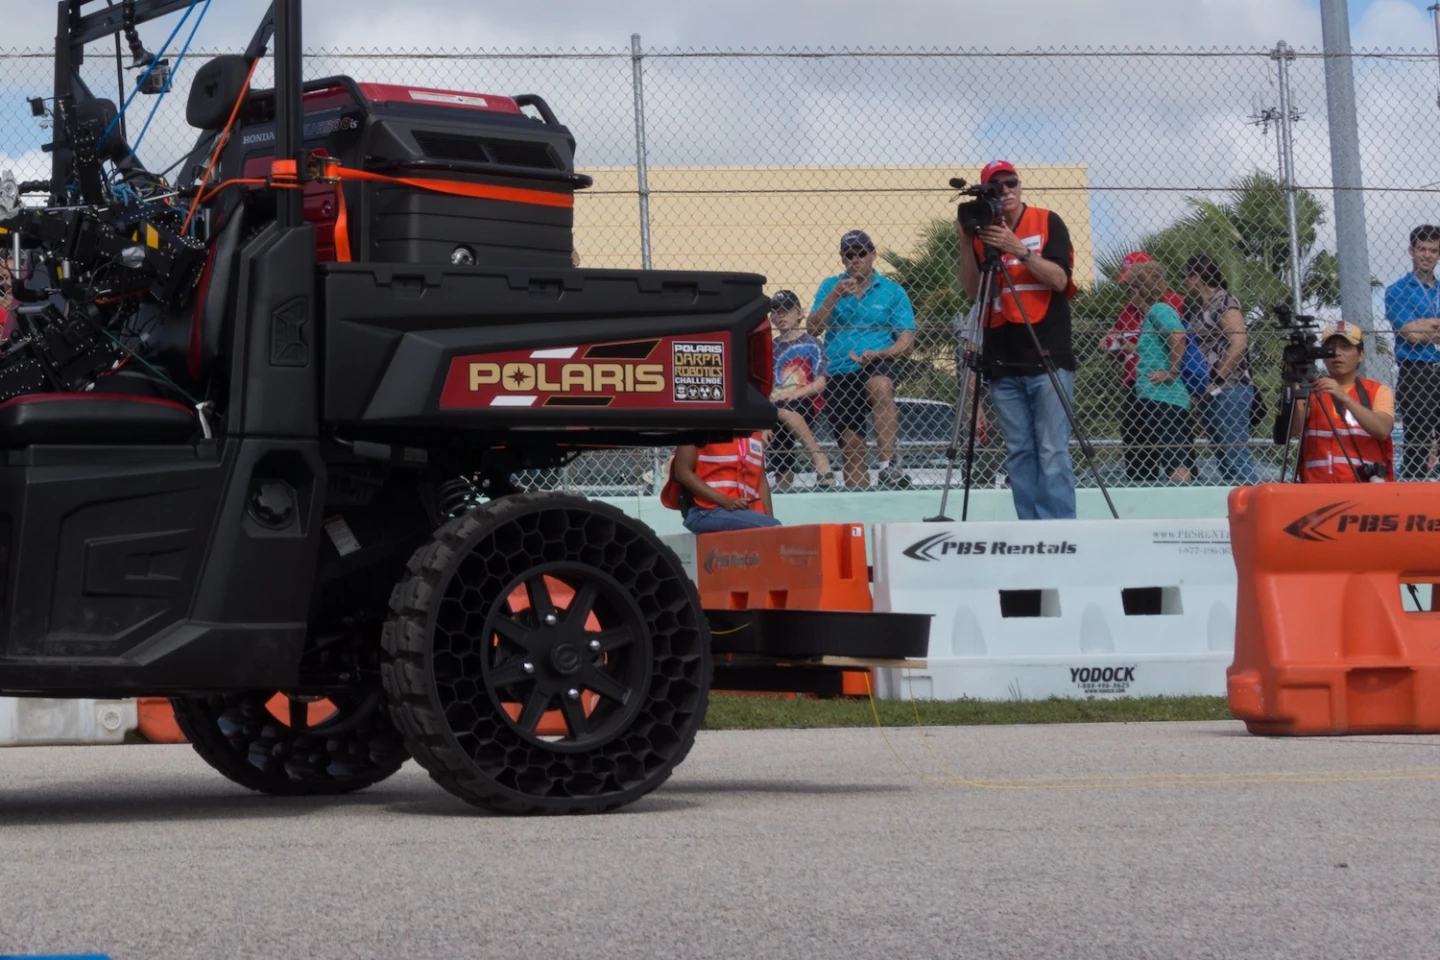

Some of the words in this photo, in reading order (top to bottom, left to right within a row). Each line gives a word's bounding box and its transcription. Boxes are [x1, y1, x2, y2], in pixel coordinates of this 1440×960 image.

[242, 131, 276, 145] HONDA
[674, 344, 722, 353] POLARIS
[674, 352, 722, 366] DARPA
[468, 361, 666, 392] POLARIS
[674, 366, 723, 377] ROBOTICS
[674, 376, 722, 384] CHALLENGE
[1336, 514, 1400, 533] PBS
[940, 541, 987, 555] PBS
[990, 540, 1078, 555] Rentals
[1069, 666, 1136, 683] YODOCK
